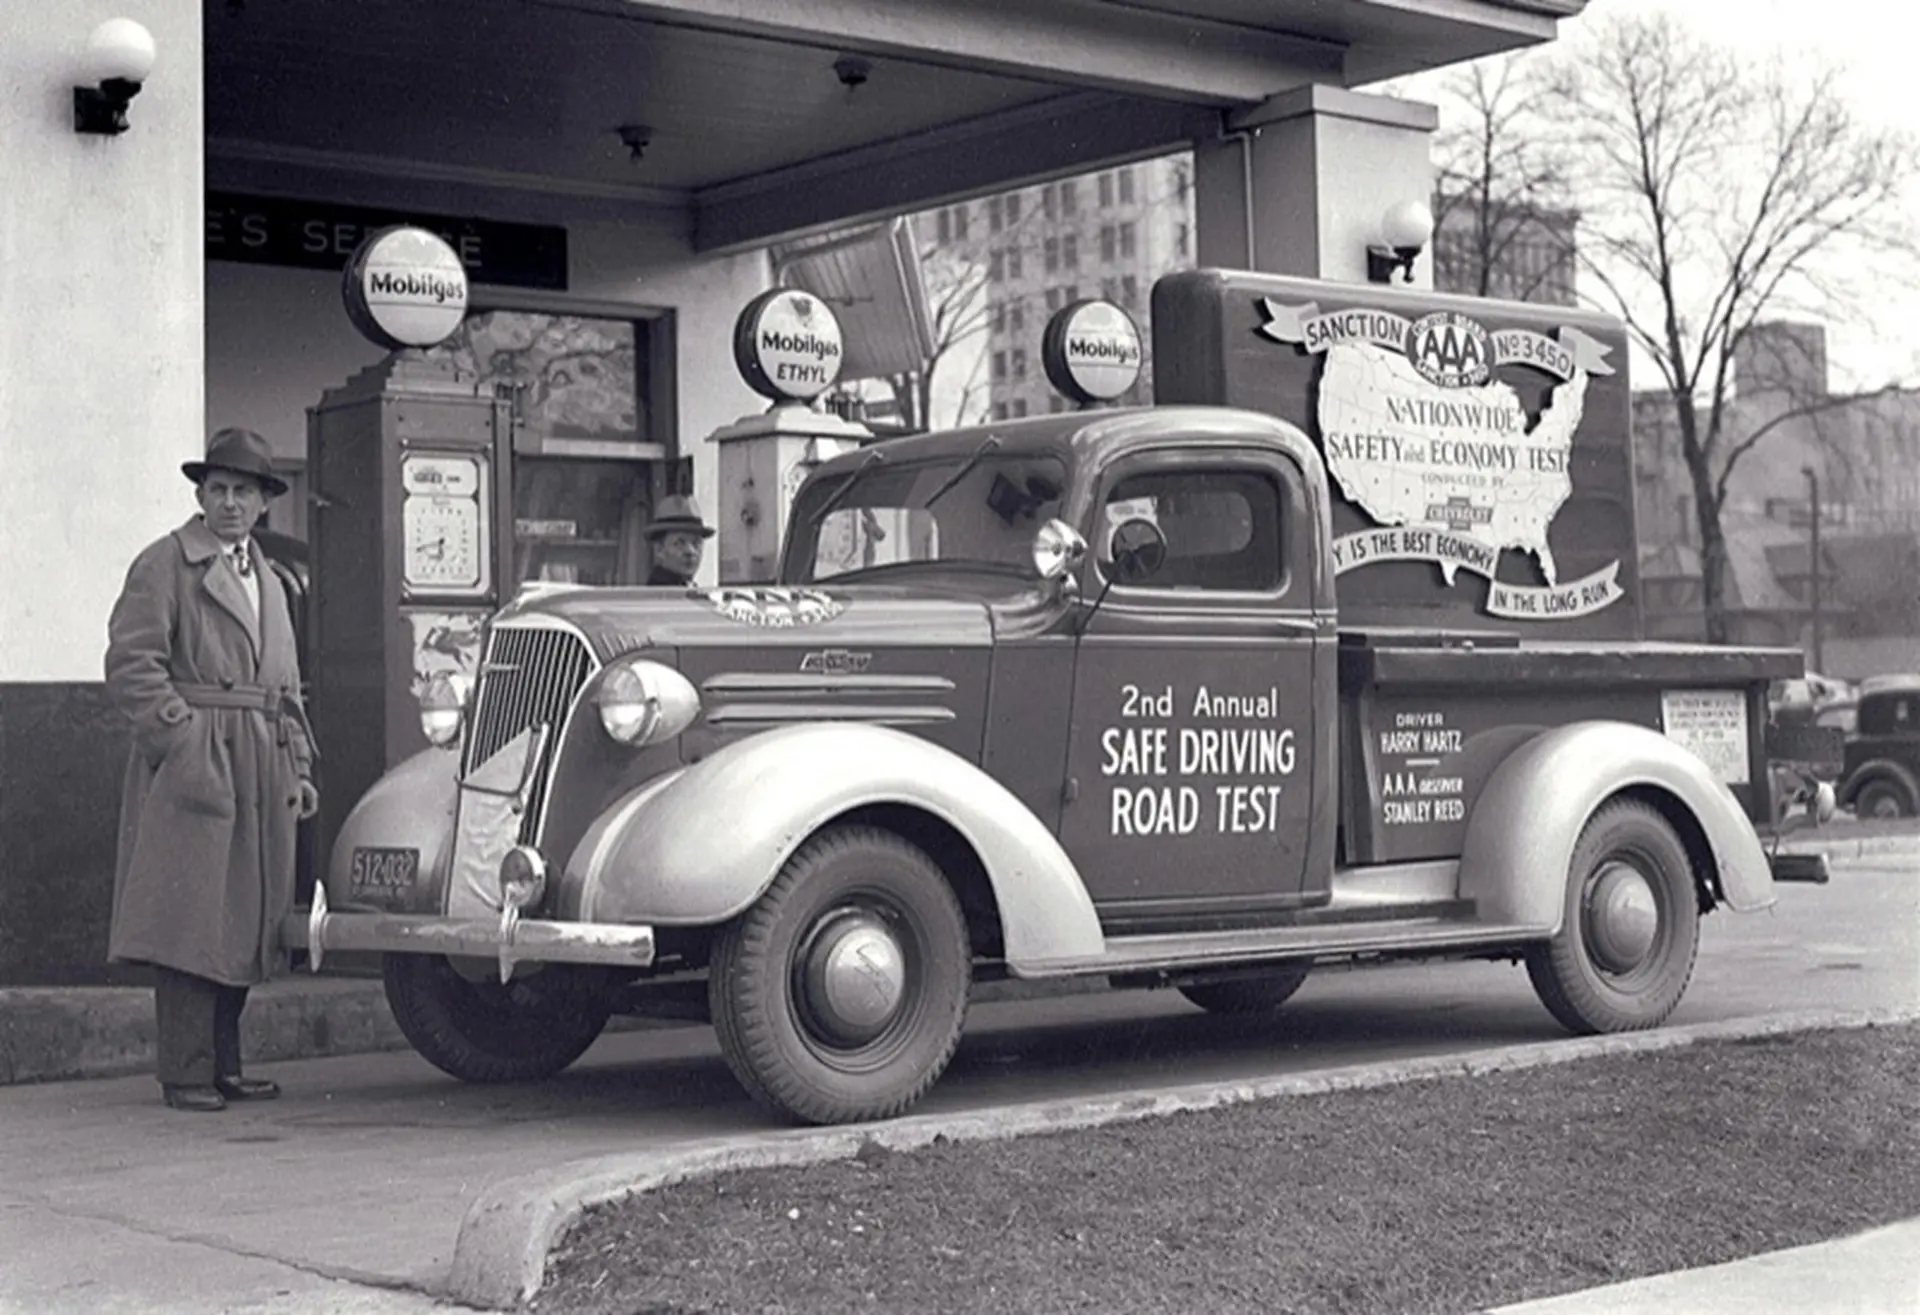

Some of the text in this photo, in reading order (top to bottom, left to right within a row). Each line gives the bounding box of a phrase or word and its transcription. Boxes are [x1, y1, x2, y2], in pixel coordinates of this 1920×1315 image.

[370, 271, 464, 304] Mobilgas
[761, 330, 839, 362] Mobilgas
[1306, 313, 1402, 347] SANCTION
[1069, 336, 1138, 364] Mobilgas
[1422, 326, 1480, 373] AAA
[776, 361, 827, 384] ETHYL
[1386, 396, 1518, 432] NATIONWIDE
[1328, 432, 1404, 462] SAFETY
[1430, 440, 1518, 470] ECONOMY
[1527, 447, 1568, 473] TEST
[1350, 538, 1365, 559] IS
[1371, 533, 1397, 556] THE
[1403, 532, 1431, 553] BEST
[1437, 534, 1493, 571] ECONOMY
[1514, 593, 1536, 613] THE
[1543, 590, 1577, 613] LONG
[1582, 584, 1610, 607] RUN
[1121, 684, 1278, 719] 2nd Annual
[1395, 712, 1444, 728] DRIVER
[1101, 727, 1296, 776] SAFE DRIVING
[1380, 729, 1463, 754] HARRY HARTZ
[1111, 785, 1281, 836] ROAD TEST
[1383, 798, 1465, 825] STANLEY REED
